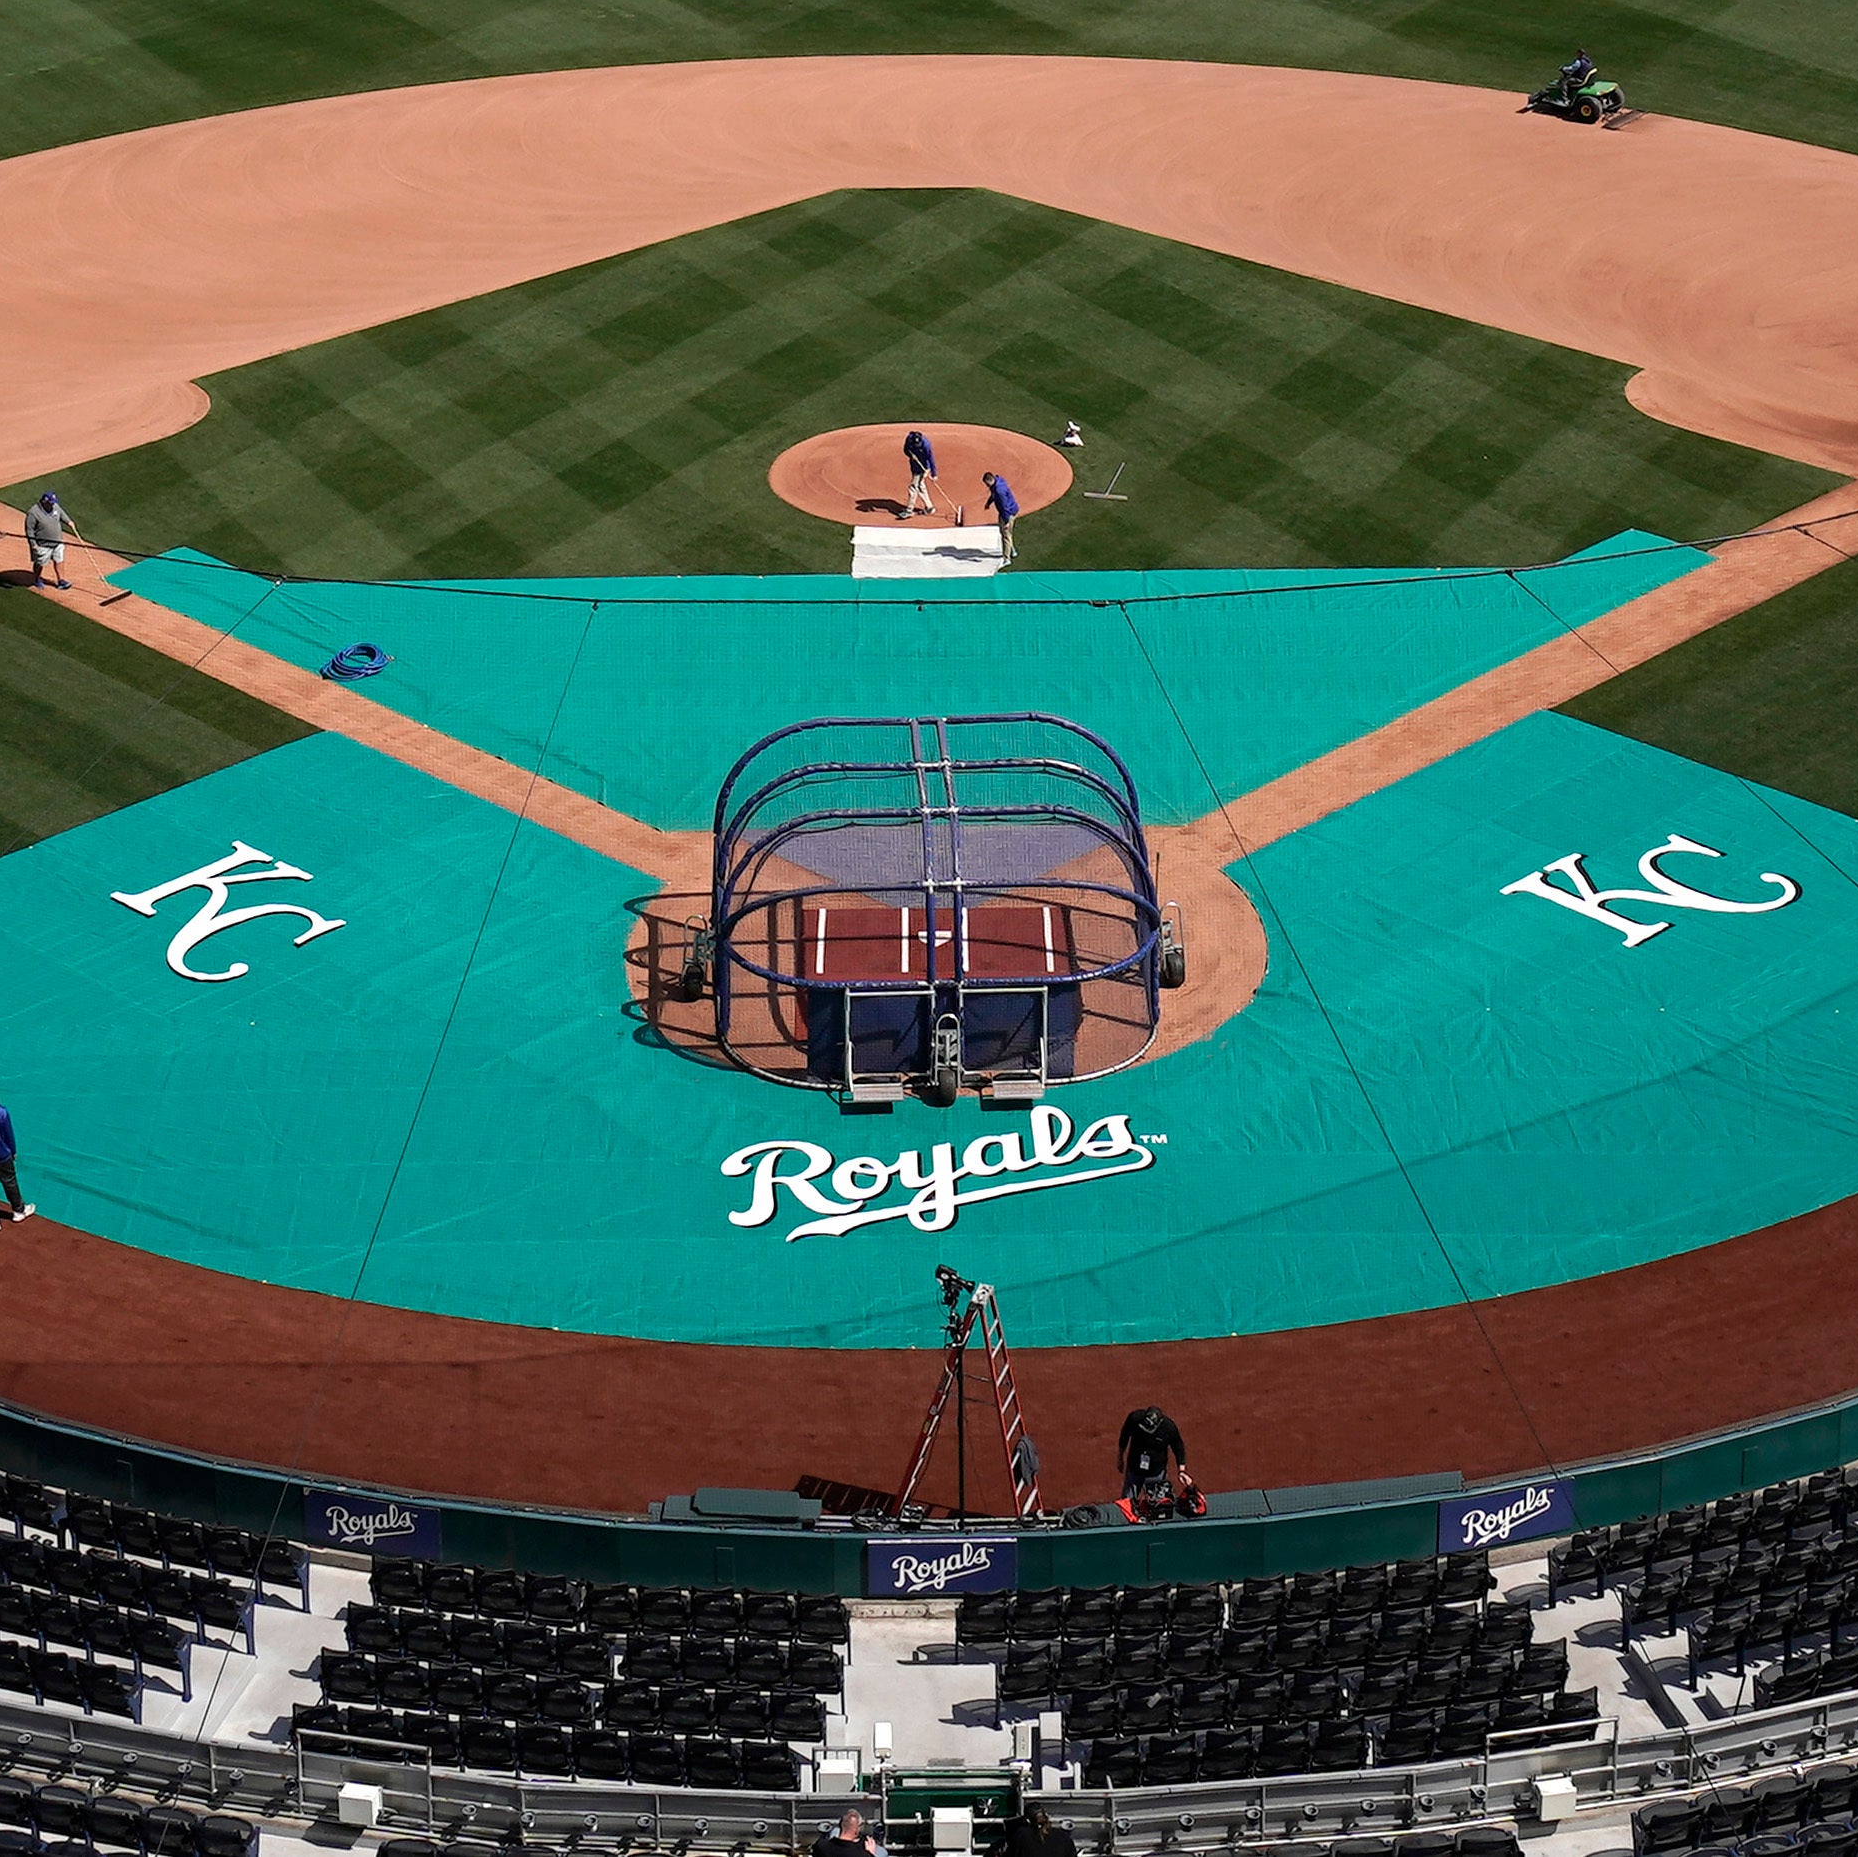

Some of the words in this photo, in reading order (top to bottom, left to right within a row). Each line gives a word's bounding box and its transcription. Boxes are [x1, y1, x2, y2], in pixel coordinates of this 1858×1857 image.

[110, 840, 347, 982] KC
[1499, 833, 1803, 948] KC
[720, 1105, 1154, 1243] Royals
[325, 1503, 416, 1546] Royals
[1461, 1487, 1552, 1547] Royals
[891, 1542, 992, 1593] Royals
